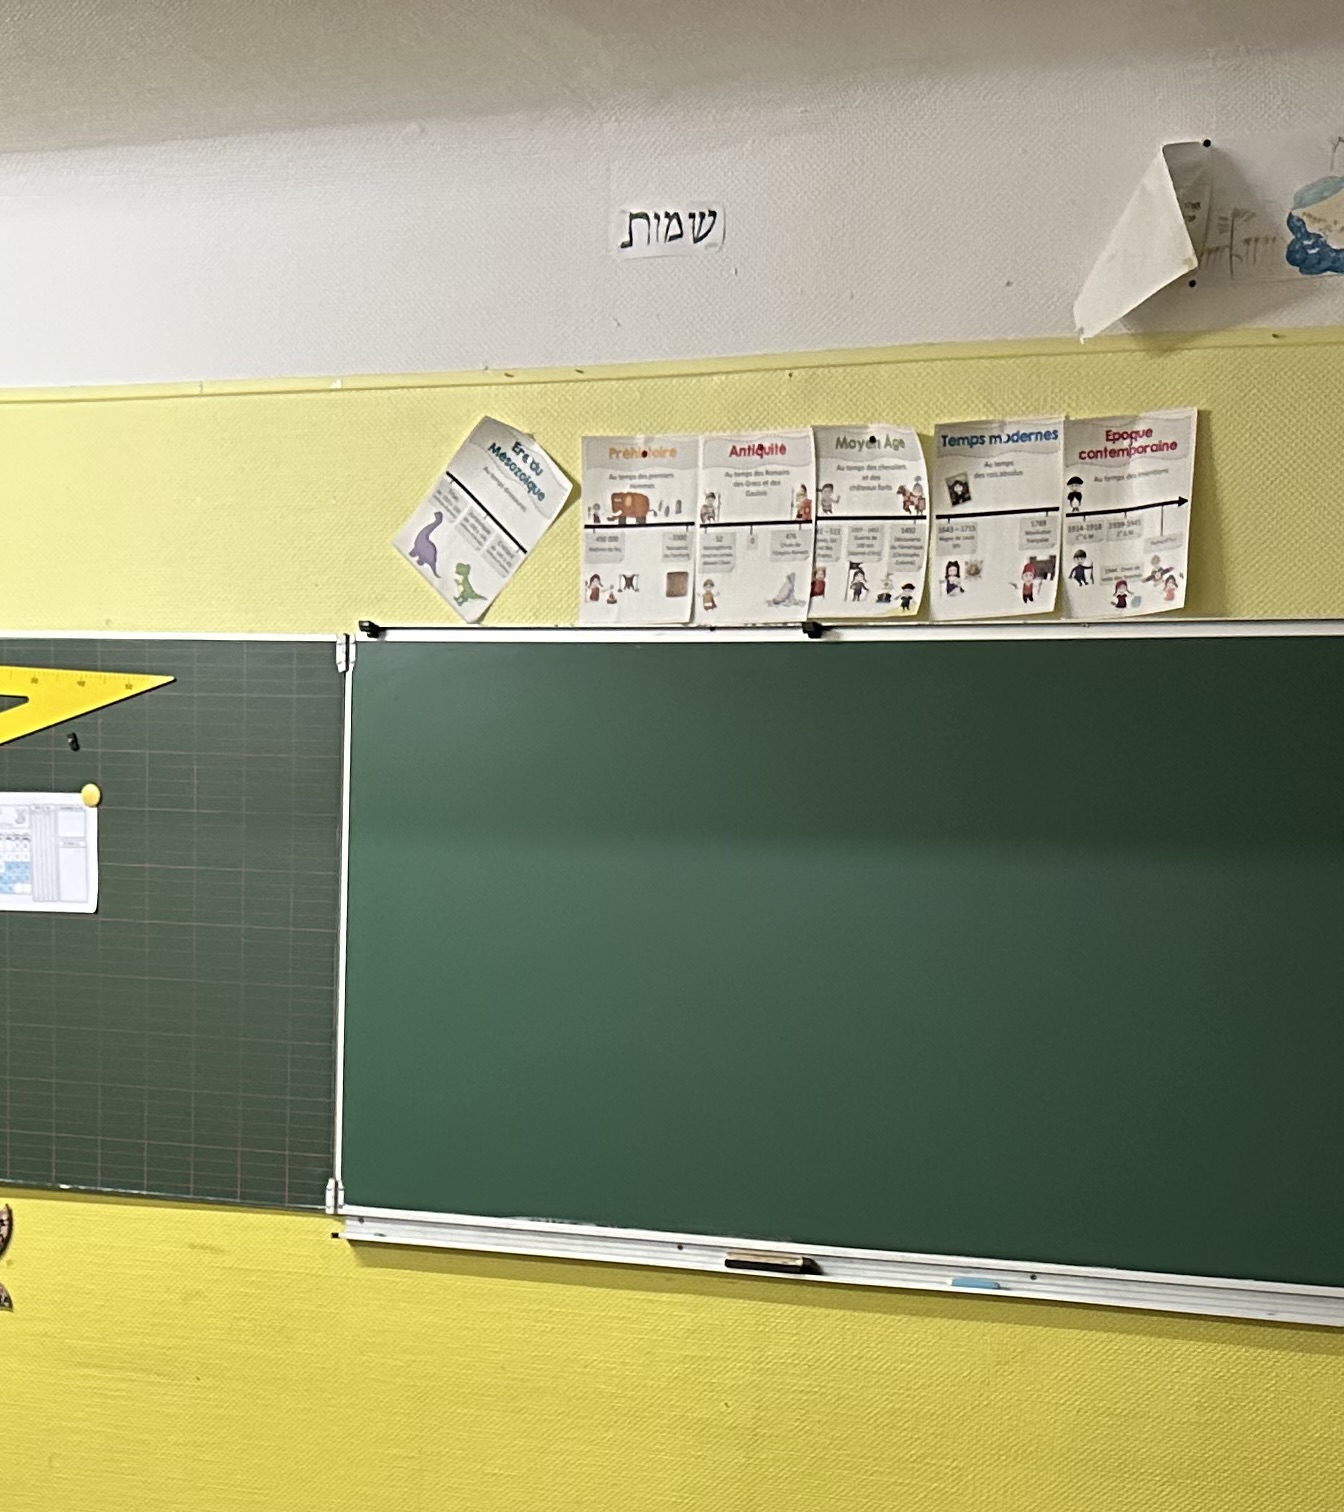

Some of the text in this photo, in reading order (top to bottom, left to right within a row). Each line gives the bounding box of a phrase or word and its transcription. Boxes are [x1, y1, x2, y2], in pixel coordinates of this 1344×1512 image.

[620, 209, 718, 249] שמות
[941, 433, 986, 449] Temps
[1078, 439, 1178, 462] contemporaine
